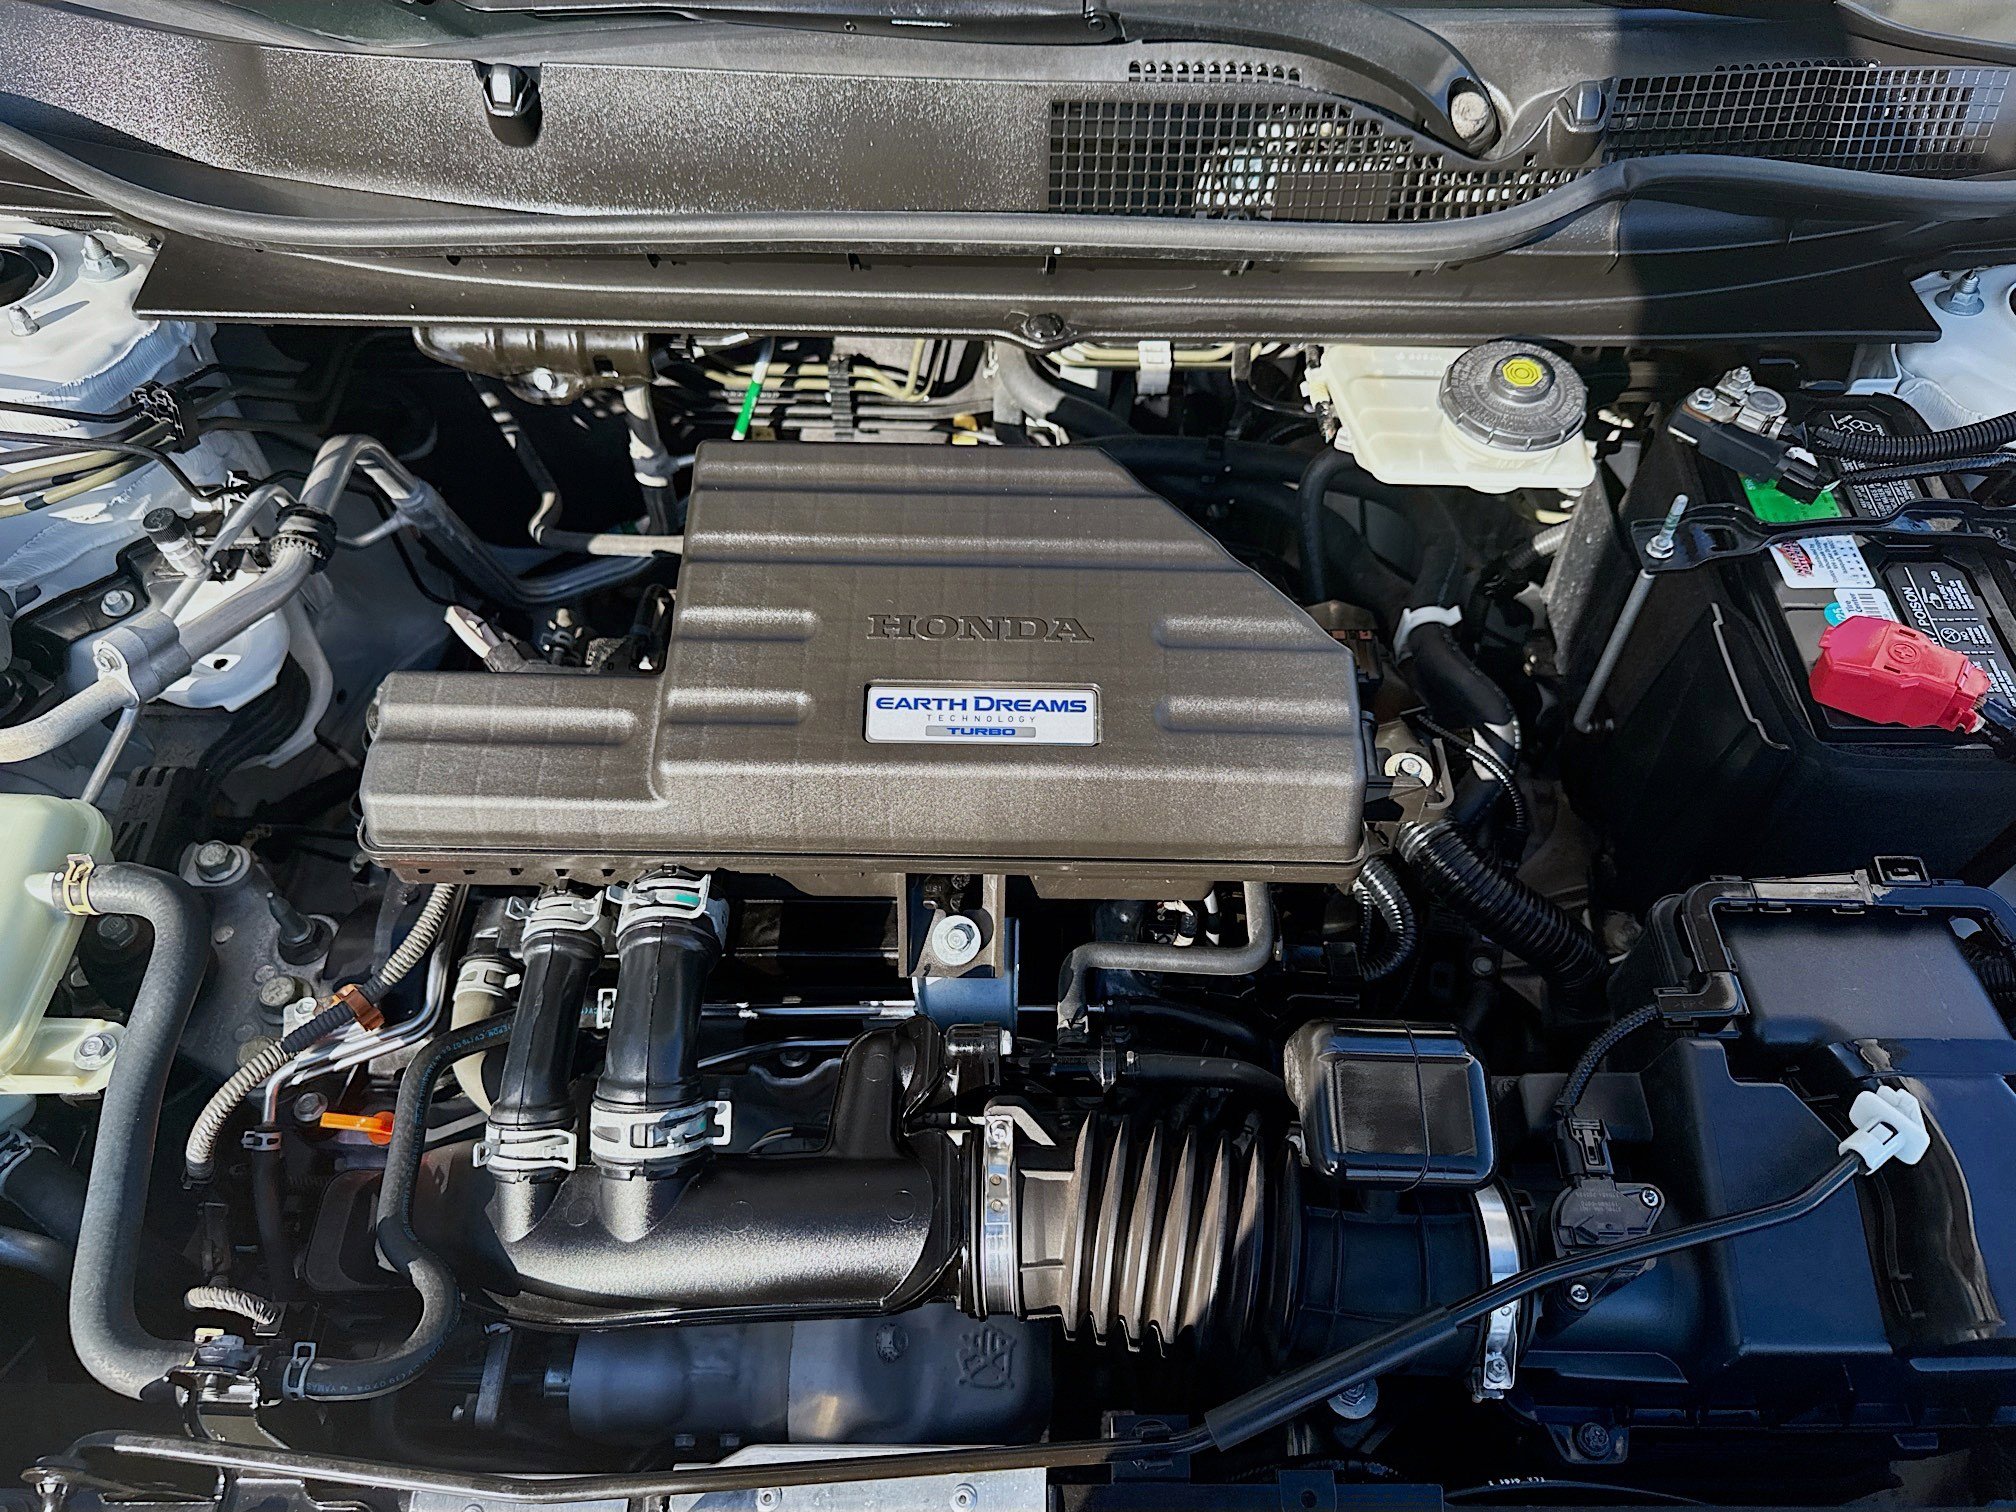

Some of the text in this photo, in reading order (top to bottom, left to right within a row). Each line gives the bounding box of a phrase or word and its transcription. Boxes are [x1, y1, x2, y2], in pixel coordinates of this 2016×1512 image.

[1901, 586, 1930, 627] POISON
[867, 614, 1094, 642] HONDA
[876, 696, 1088, 713] EARTH DREAMS
[926, 714, 1037, 723] TECHNOLOGY
[946, 727, 1017, 736] TURBO
